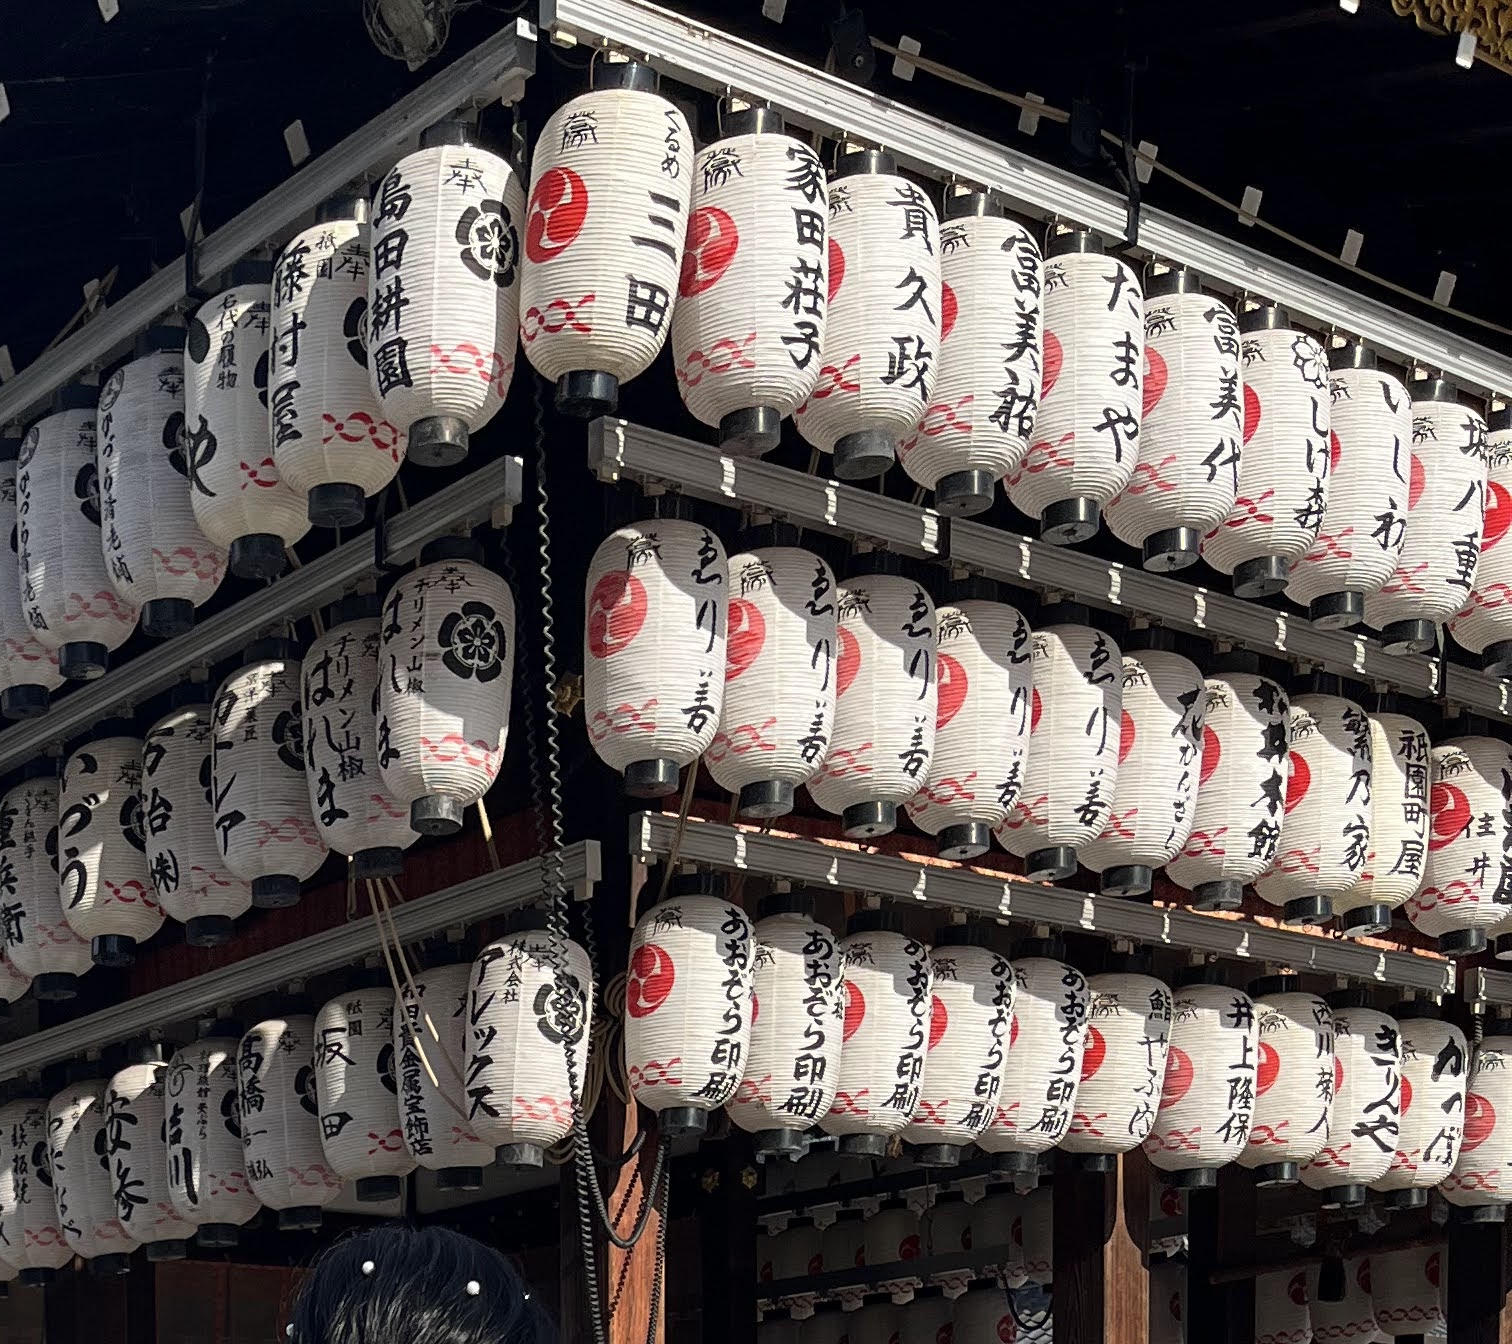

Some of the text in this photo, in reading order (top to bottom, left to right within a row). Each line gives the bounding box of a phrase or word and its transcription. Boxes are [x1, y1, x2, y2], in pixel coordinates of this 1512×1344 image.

[441, 158, 488, 195] 奉
[315, 230, 337, 280] 祇園
[335, 243, 370, 282] 奉
[371, 167, 414, 400] 島田耕園
[780, 144, 828, 370] 家田荘子
[880, 182, 938, 402] 貴久政
[216, 293, 239, 390] 名代の履物
[270, 240, 311, 449] 藤村屋
[1093, 262, 1141, 463] たまや
[1200, 301, 1243, 497] 富美代
[405, 577, 435, 694] チリメン山椒
[437, 566, 476, 595] 奉
[336, 631, 366, 782] チリメン山椒
[1388, 729, 1431, 881] 祇園町屋
[464, 946, 507, 1121] アレックス
[500, 939, 529, 1004] 株式会社
[690, 907, 749, 1105] あおぞら印刷
[777, 929, 835, 1120] あおぞら印刷
[1214, 995, 1256, 1145] 井上隆保
